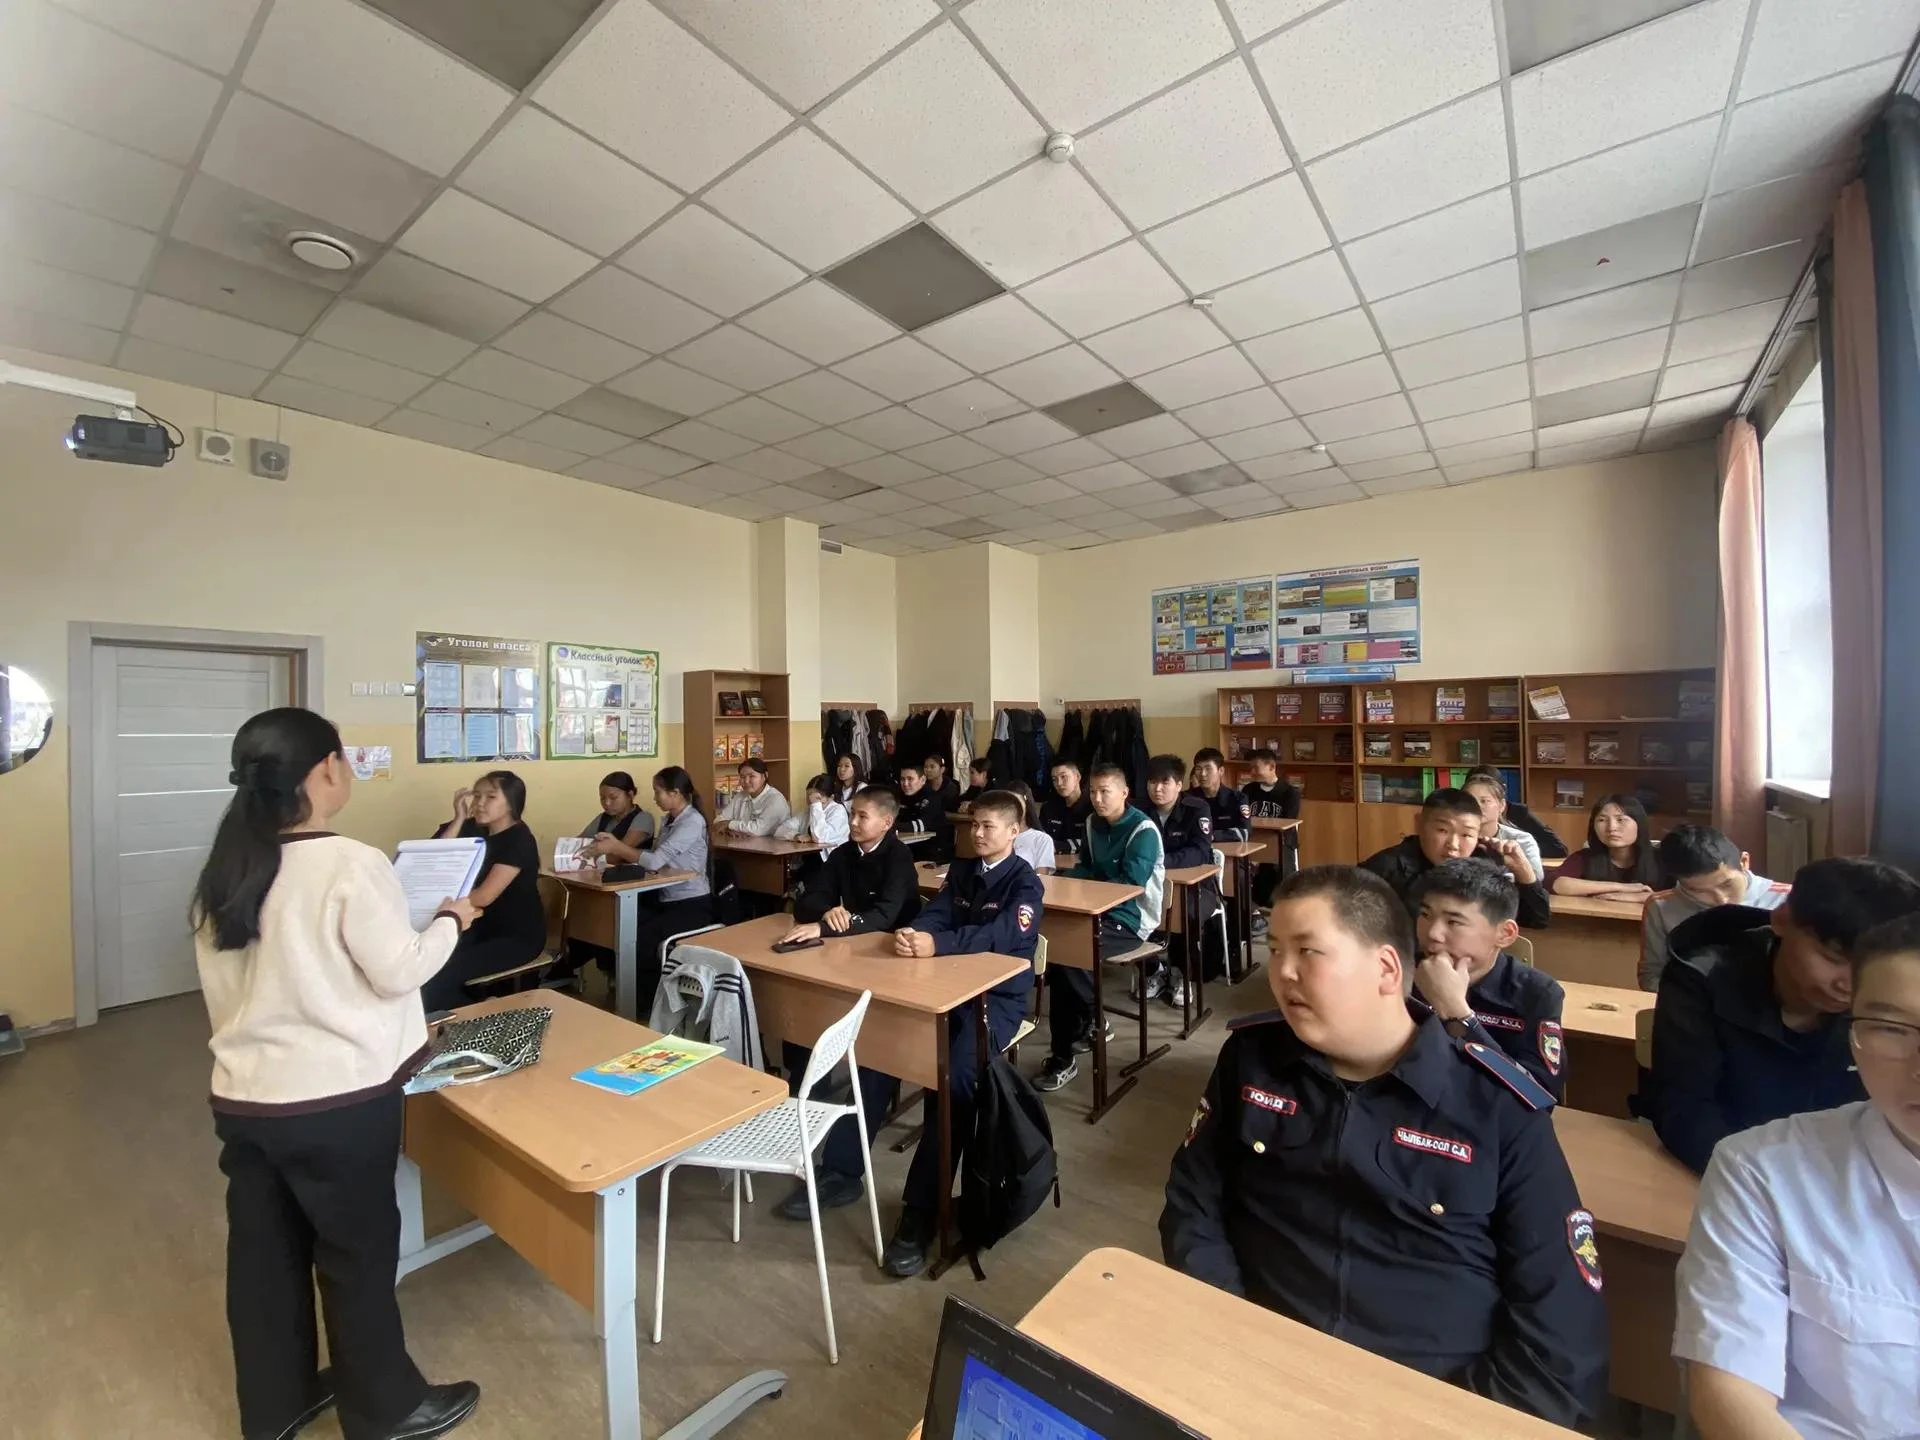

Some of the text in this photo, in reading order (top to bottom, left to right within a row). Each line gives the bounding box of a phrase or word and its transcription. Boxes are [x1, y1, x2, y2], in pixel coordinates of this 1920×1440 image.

[447, 636, 532, 652] Уголок класса
[570, 649, 641, 666] Классный уголок
[1250, 1090, 1284, 1110] ЮИД
